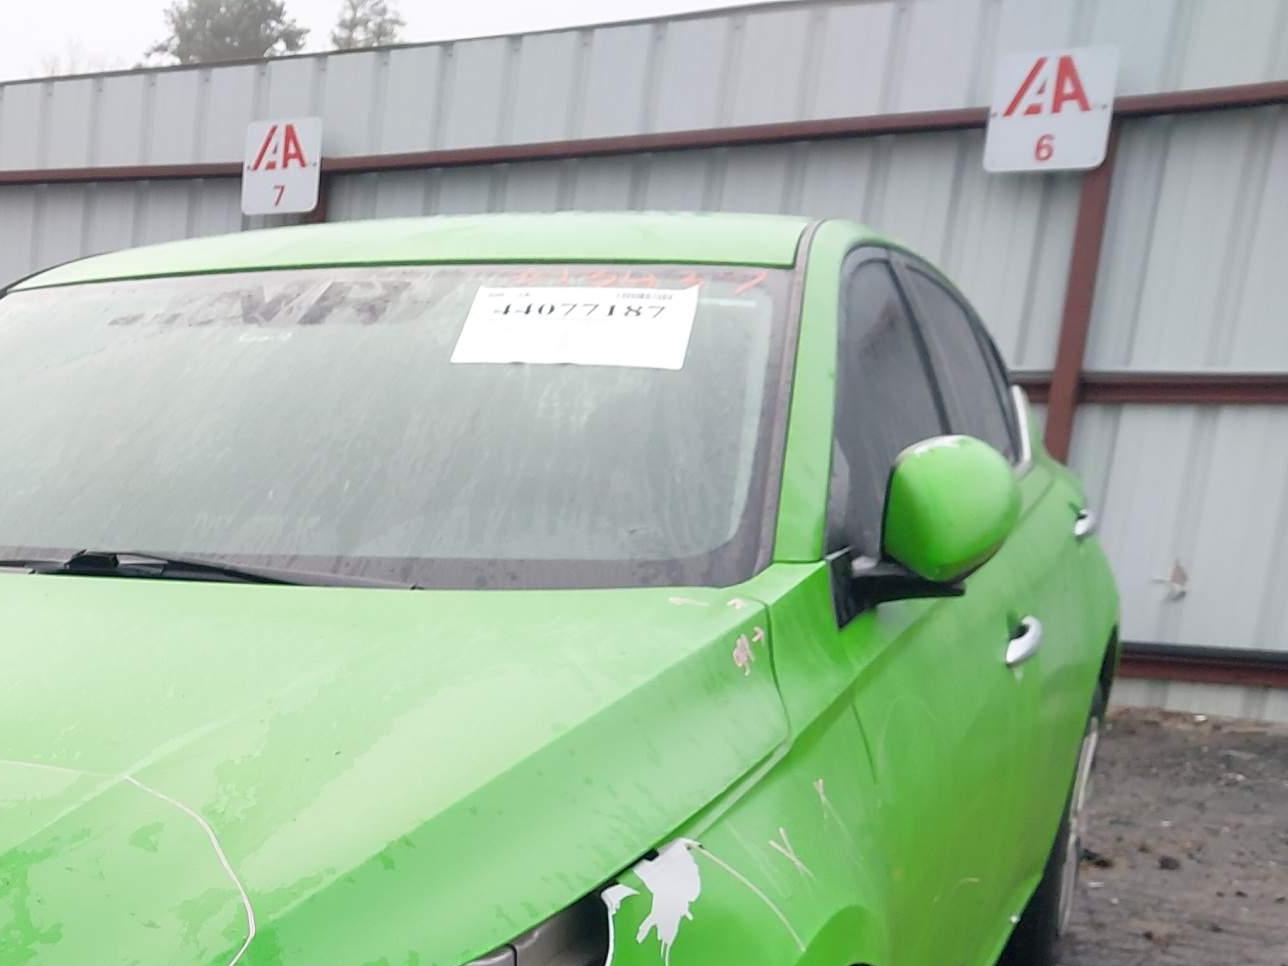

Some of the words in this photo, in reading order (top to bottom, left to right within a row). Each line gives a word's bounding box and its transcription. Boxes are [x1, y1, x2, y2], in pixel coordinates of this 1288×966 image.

[1034, 133, 1055, 162] 6
[273, 184, 285, 207] 7
[493, 303, 667, 319] 44077187
